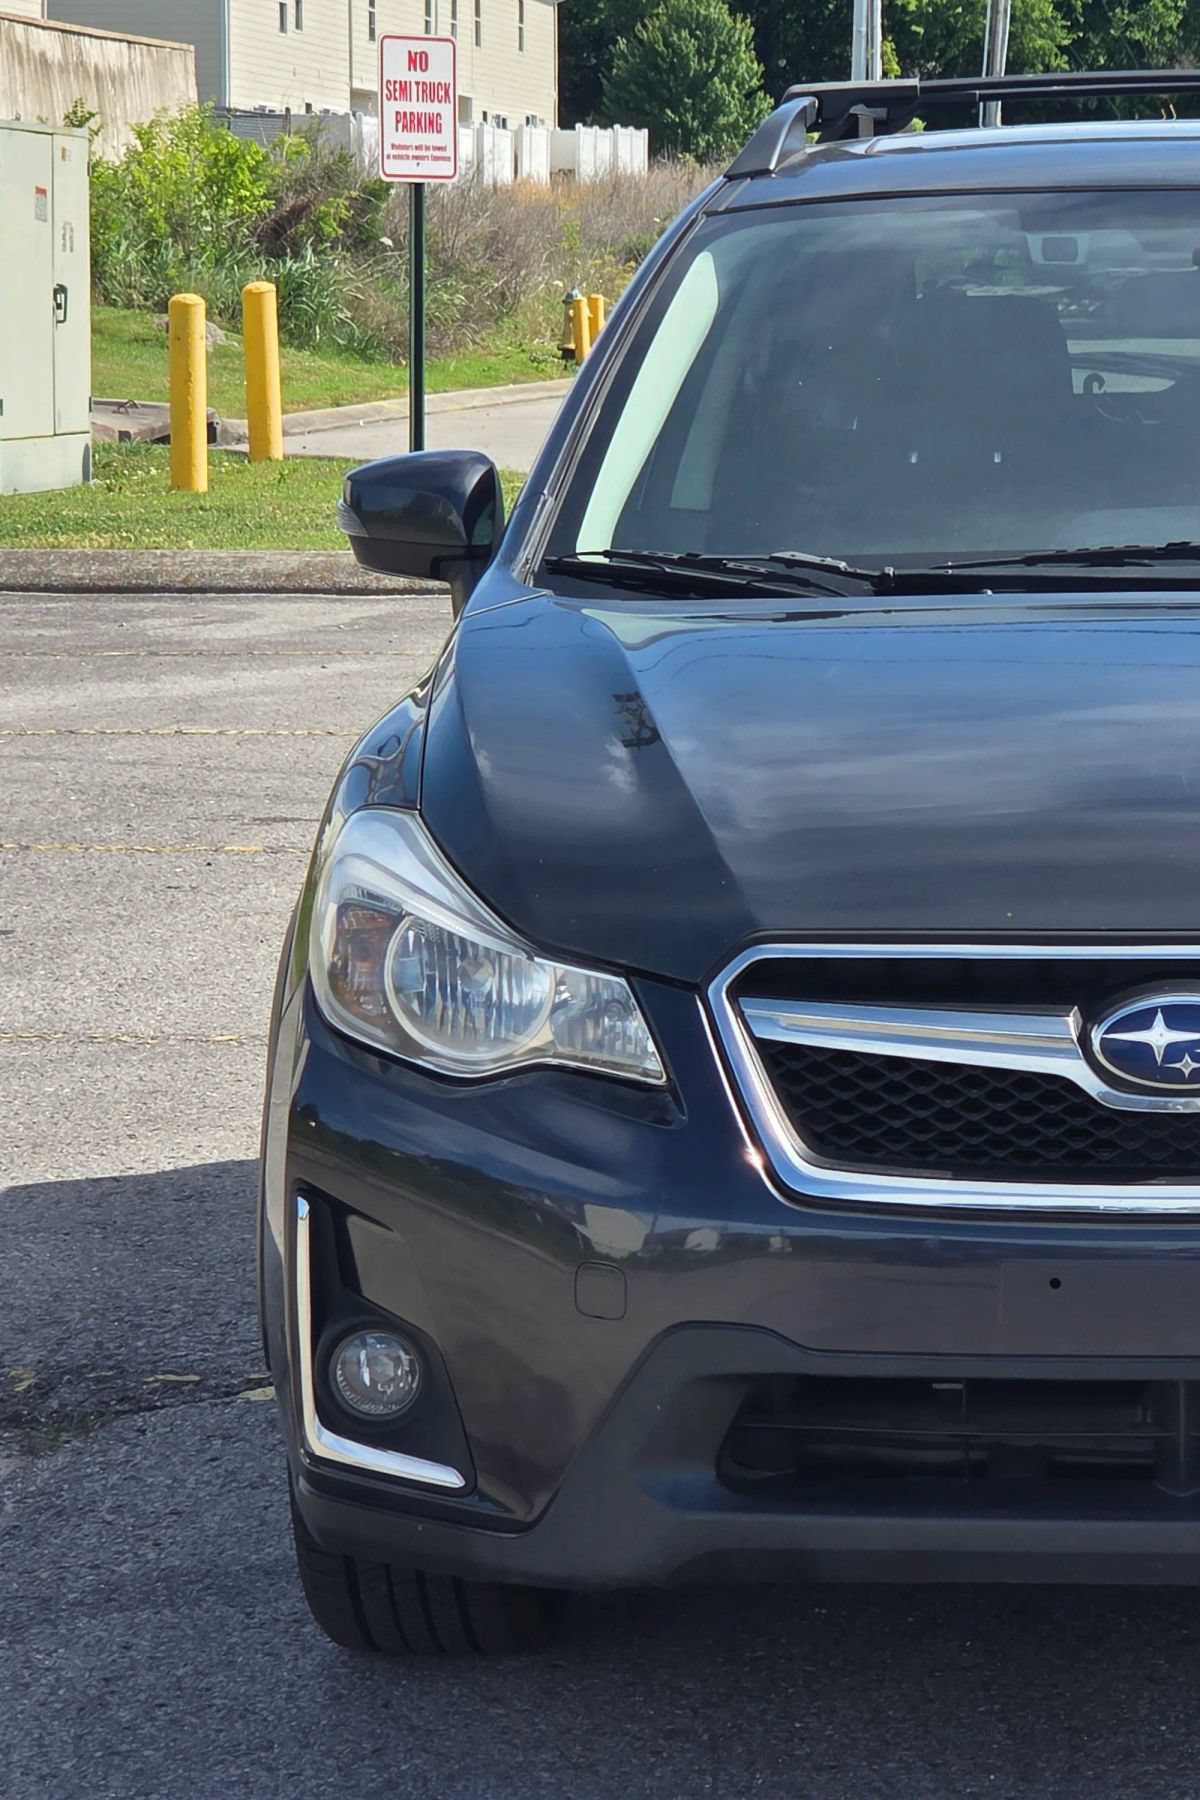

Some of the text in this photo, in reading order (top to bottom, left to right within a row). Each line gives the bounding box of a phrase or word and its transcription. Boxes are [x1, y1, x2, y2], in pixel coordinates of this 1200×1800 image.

[407, 50, 429, 72] NO
[385, 79, 452, 104] SEMI TRUCK
[395, 111, 442, 134] PARKING
